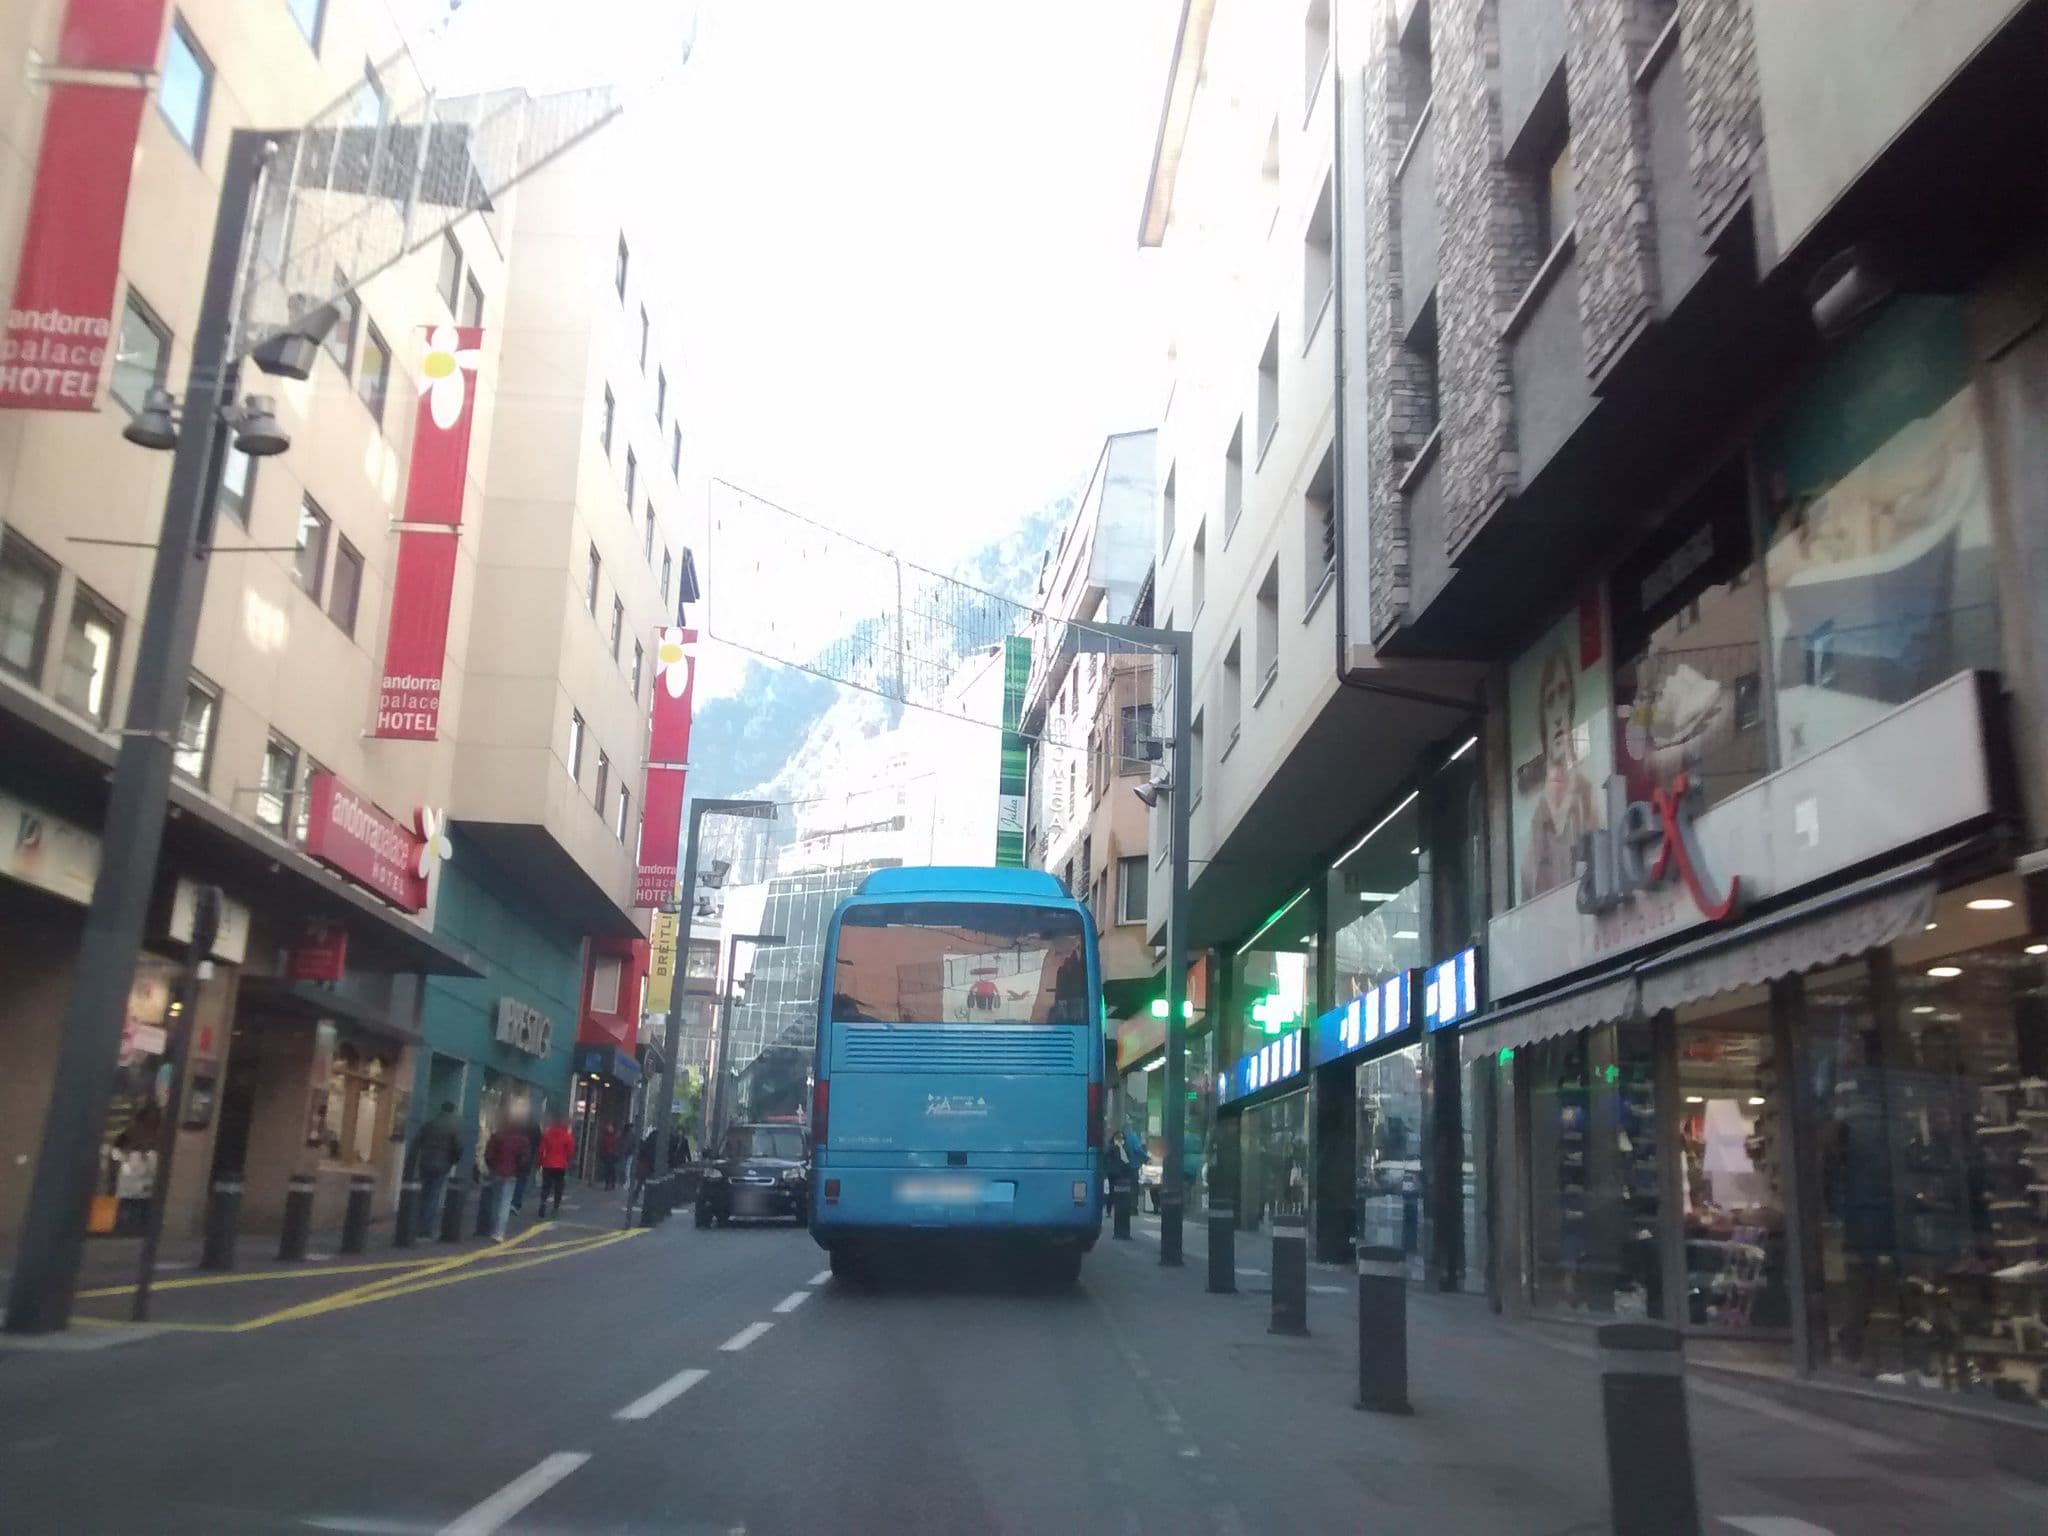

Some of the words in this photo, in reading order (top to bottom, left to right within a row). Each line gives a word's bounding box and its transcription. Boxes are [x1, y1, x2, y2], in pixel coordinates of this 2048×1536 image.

[8, 309, 109, 338] andorra
[0, 337, 104, 366] palace
[0, 365, 95, 397] HOTEL
[383, 674, 441, 691] andorra
[380, 692, 440, 710] palace
[378, 711, 436, 731] HOTEL
[638, 864, 676, 875] andorra
[636, 876, 676, 889] palace
[656, 914, 673, 977] BREITLI
